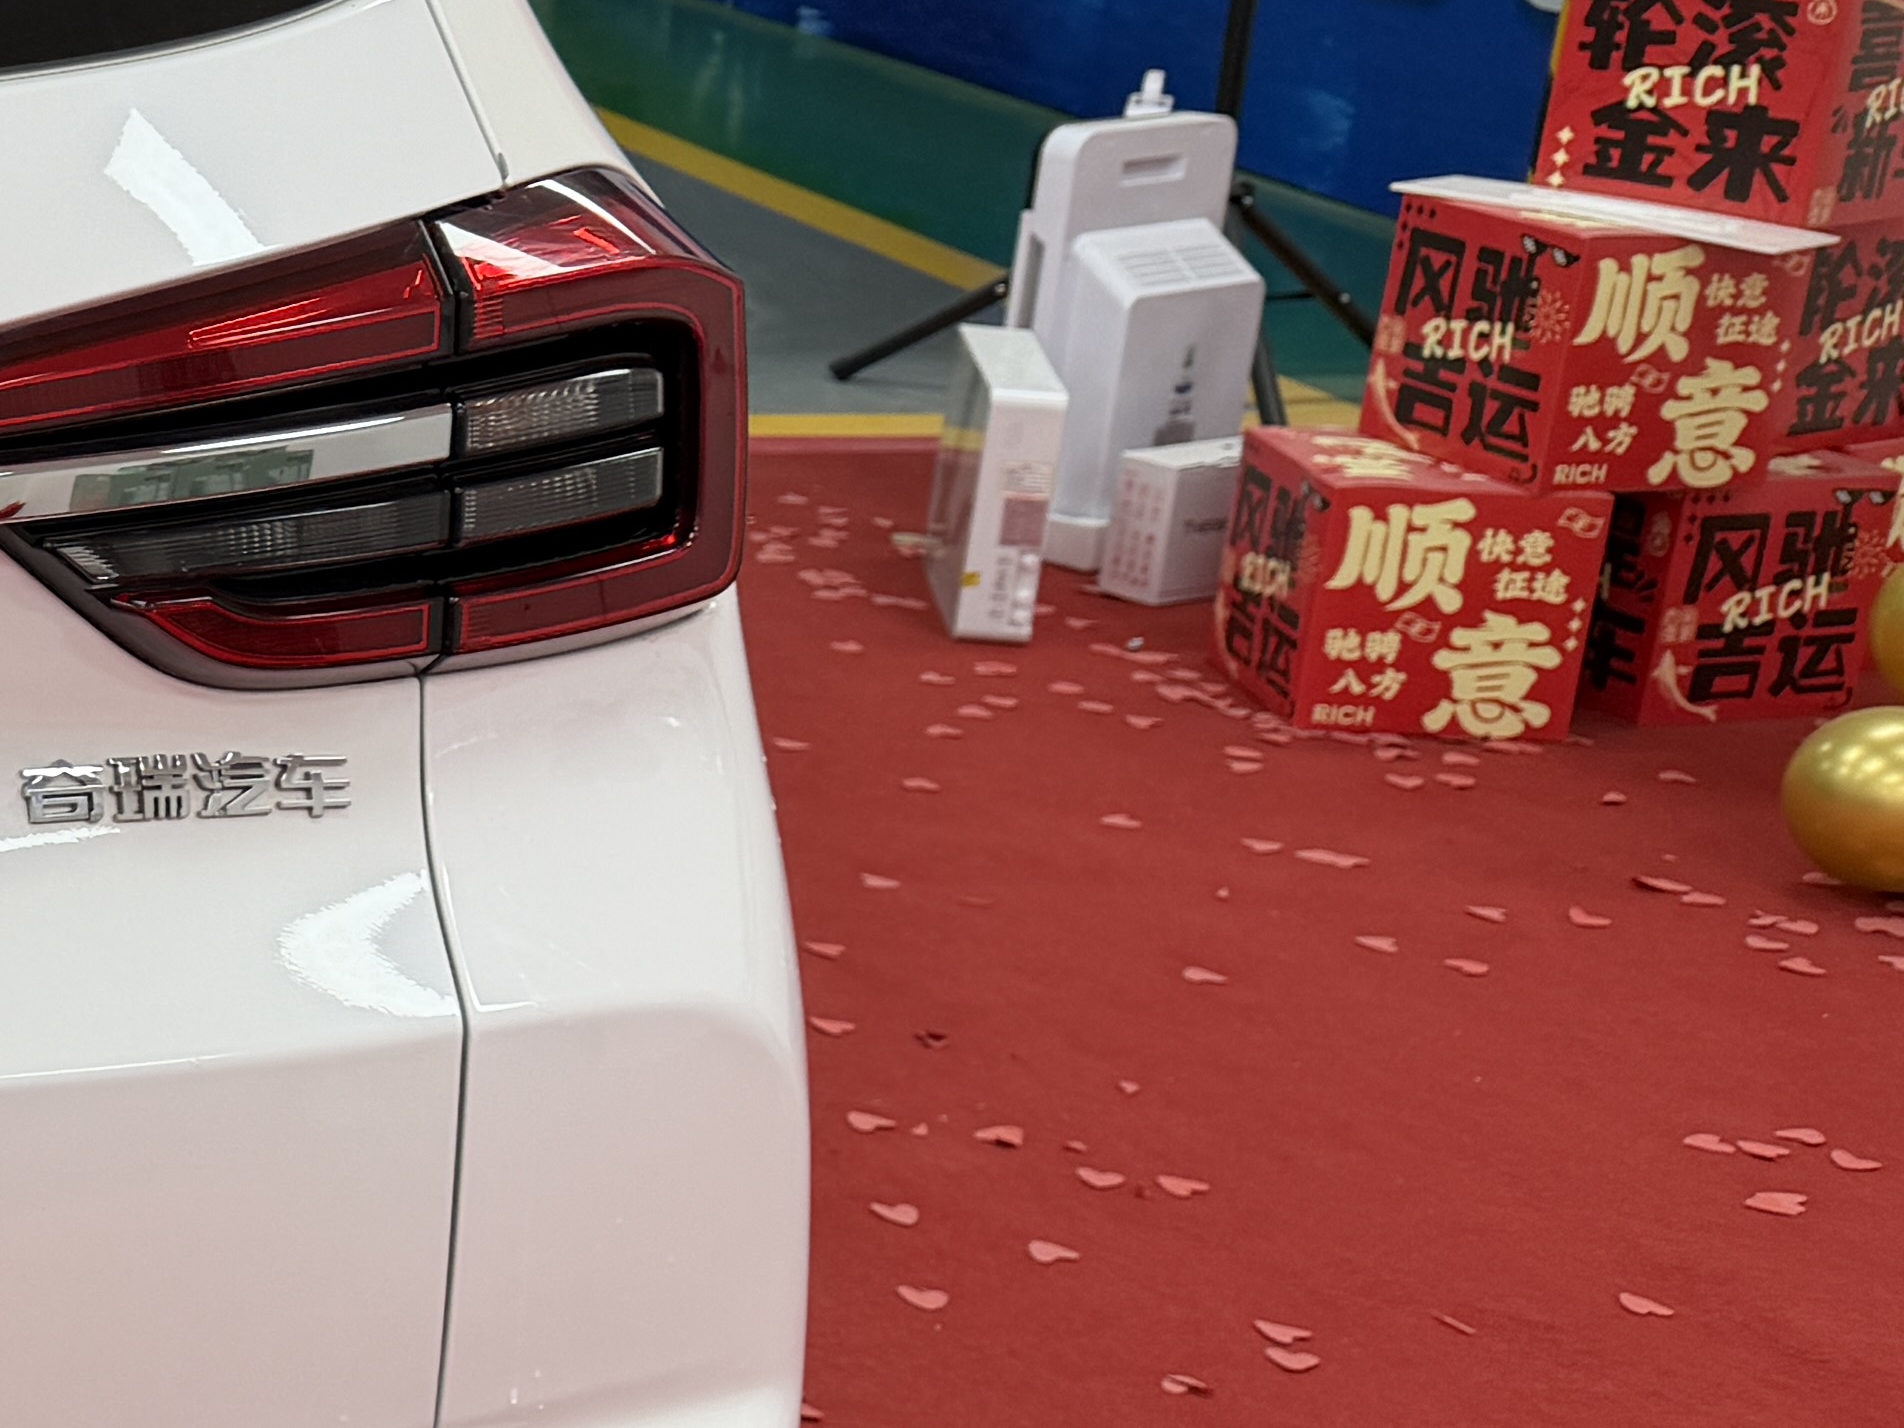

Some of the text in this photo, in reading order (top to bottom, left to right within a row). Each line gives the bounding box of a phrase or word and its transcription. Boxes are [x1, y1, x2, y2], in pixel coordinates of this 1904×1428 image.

[1621, 62, 1764, 110] RICH
[1581, 99, 1800, 204] 金来
[1572, 243, 1706, 364] 顺
[1704, 271, 1770, 308] 快意
[1421, 316, 1516, 364] RICH
[1716, 309, 1782, 346] 征途
[1819, 298, 1904, 366] RICH
[1570, 421, 1638, 456] 八方
[1647, 356, 1770, 489] 意
[1552, 462, 1609, 485] RICH
[1323, 496, 1477, 615] 顺
[1476, 527, 1555, 567] 快意
[1493, 567, 1572, 606] 征途
[1719, 571, 1832, 634] RICH
[1420, 608, 1564, 741] 意
[1686, 607, 1859, 704] 吉运
[1328, 665, 1408, 701] 八方
[1310, 703, 1377, 727] RICH
[19, 749, 353, 825] 奇瑞汽车
